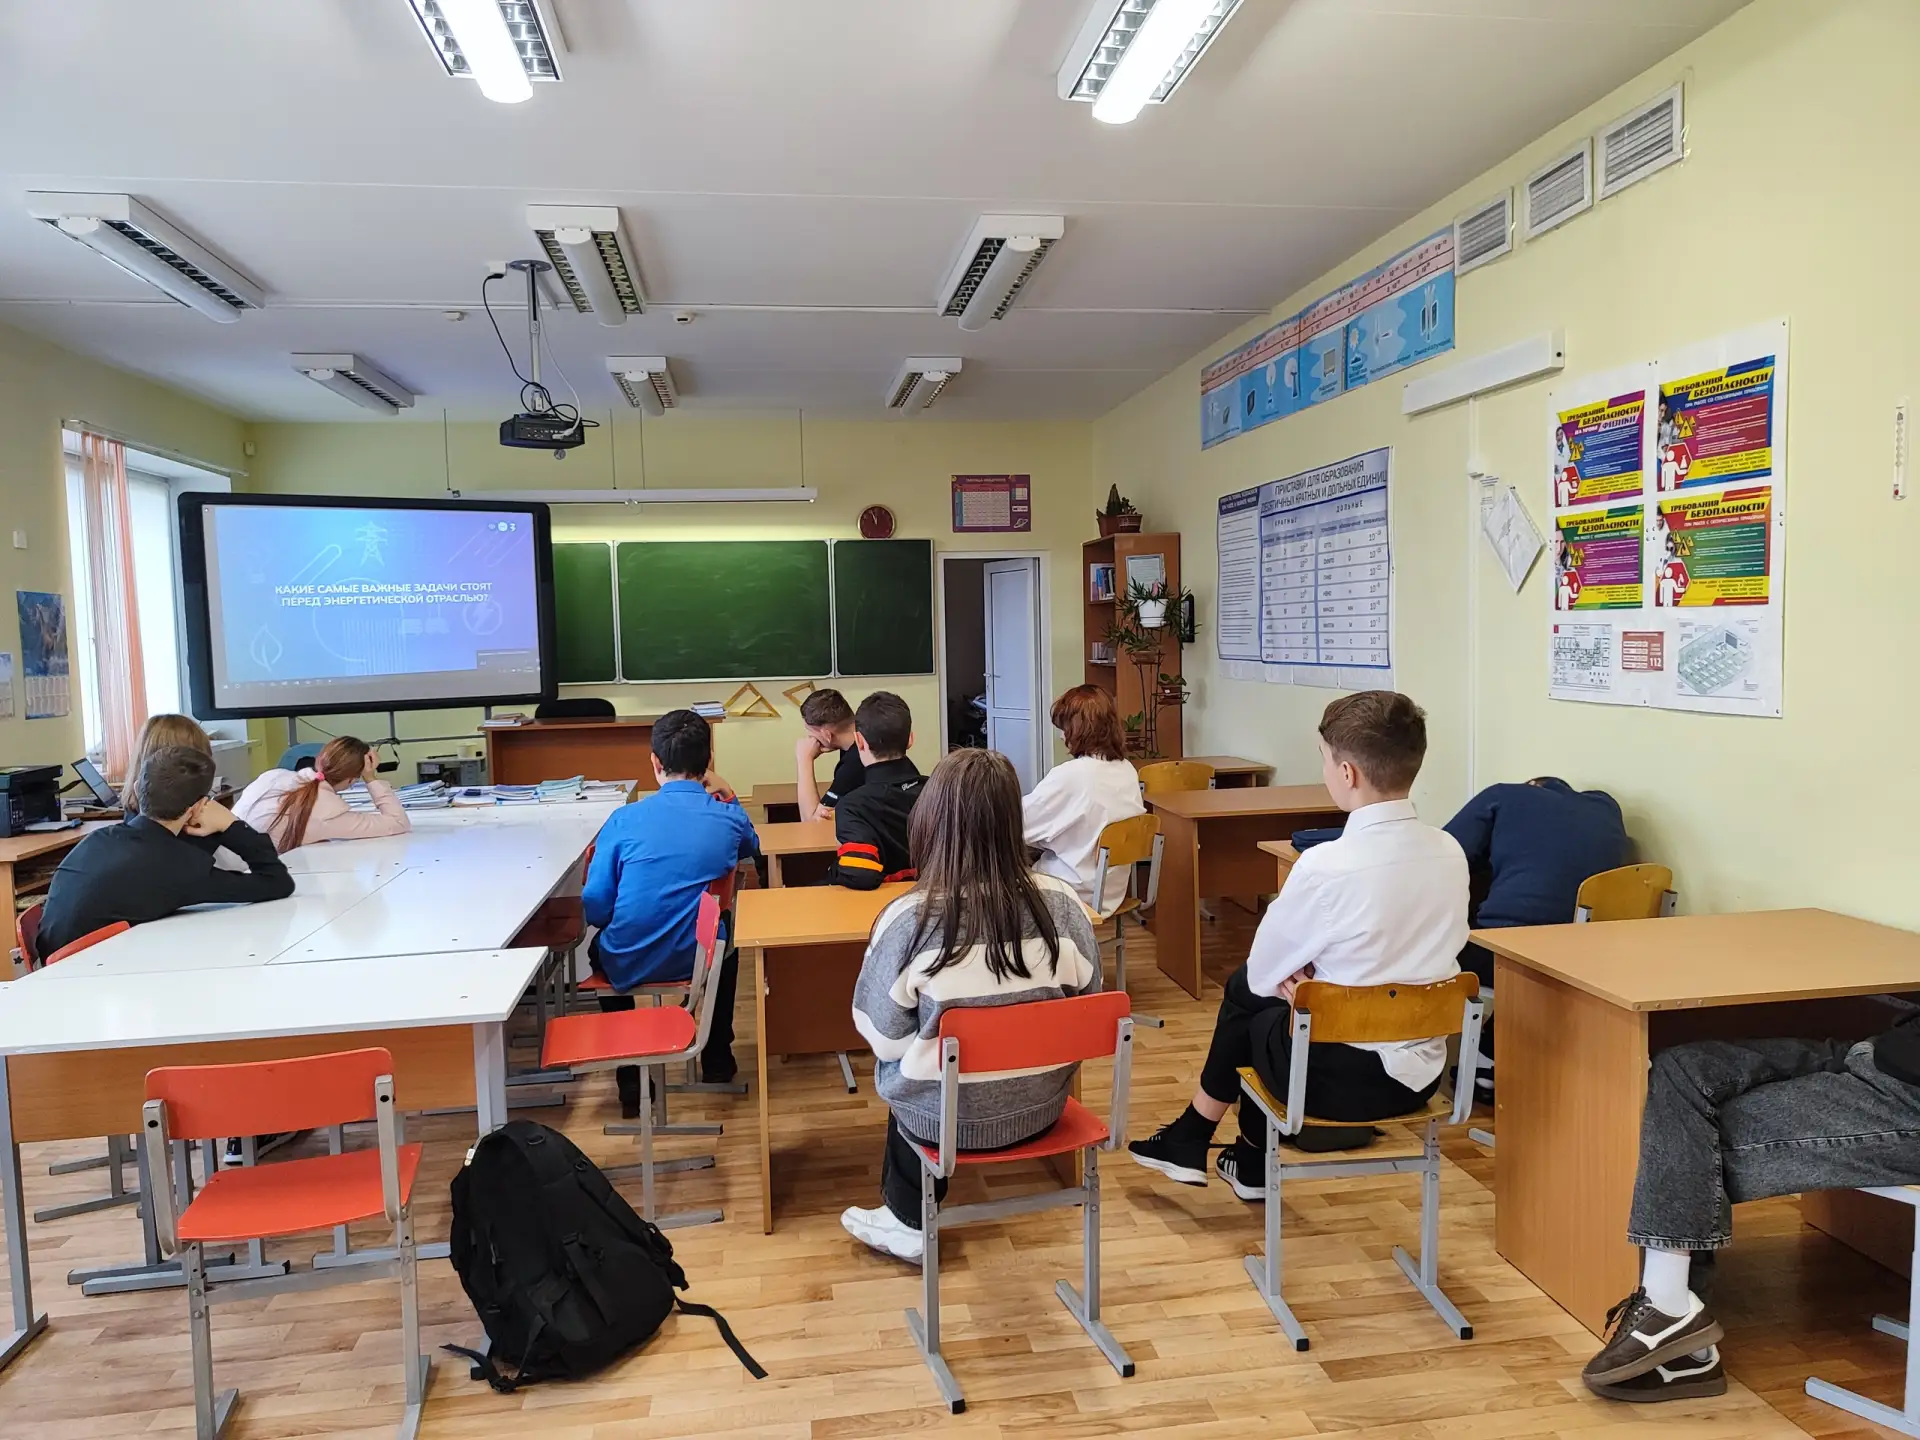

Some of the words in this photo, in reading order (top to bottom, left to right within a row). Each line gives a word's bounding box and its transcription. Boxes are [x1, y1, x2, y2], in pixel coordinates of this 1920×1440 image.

[1673, 376, 1723, 394] ТРЕБОВАНИЯ
[1694, 372, 1769, 398] БЕЗОПАСНОСТИ
[1567, 407, 1605, 421] ТРЕБОВАНИЯ
[1582, 405, 1640, 426] БЕЗОПАСНОСТИ
[1602, 416, 1636, 430] ФИЗИКИ
[1275, 478, 1306, 496] ПРИСТАВКИ
[1307, 474, 1320, 489] ДЛЯ
[1321, 460, 1364, 483] ОБРАЗОВАНИЯ
[1328, 478, 1356, 497] ДОЛЬНЫХ
[1671, 500, 1719, 512] ТРЕБОВАНИЯ
[1691, 502, 1765, 518] БЕЗОПАСНОСТИ
[1566, 517, 1604, 527] ТРЕБОВАНИЯ
[1582, 519, 1639, 533] БЕЗОПАСНОСТИ
[275, 584, 315, 594] КАКИЕ
[317, 584, 359, 594] САМЫЕ
[361, 583, 411, 593] ВАЖНЫЕ
[414, 583, 457, 593] ЗАДАЧИ
[460, 582, 492, 591] СТОЯТ
[281, 597, 321, 607] ПЕРЕД
[323, 594, 423, 606] ЭНЕРГЕТИЧЕСКОЙ
[426, 593, 488, 603] ОТРАСЛЬЮ?
[1649, 657, 1662, 667] 112
